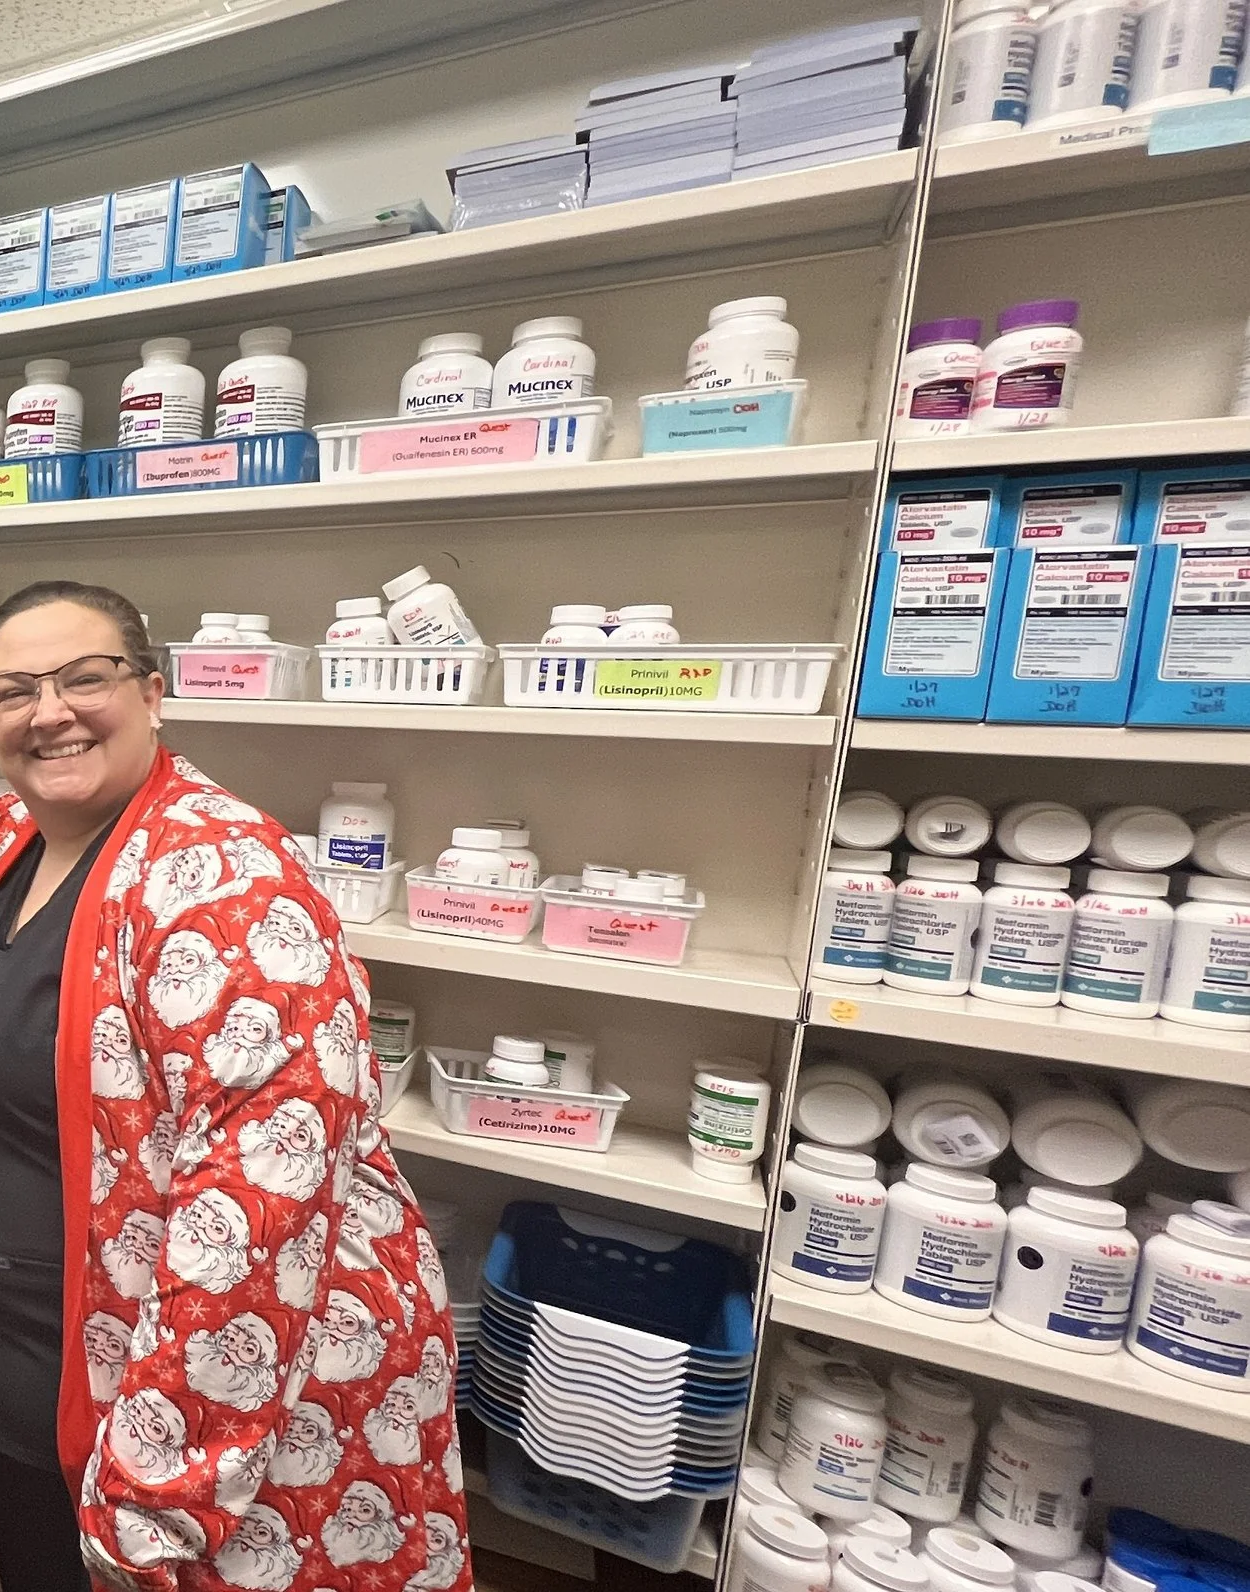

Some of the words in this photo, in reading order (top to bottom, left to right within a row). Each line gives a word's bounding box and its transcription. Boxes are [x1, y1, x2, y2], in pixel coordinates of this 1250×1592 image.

[523, 355, 576, 373] Cardinal
[416, 369, 462, 388] Cardinal
[508, 379, 573, 397] Mucinex
[406, 392, 463, 410] Mucinex
[420, 433, 461, 444] Mucinex
[464, 431, 477, 441] ER
[470, 445, 504, 457] 600mg
[900, 530, 911, 539] 10
[631, 669, 669, 679] Prinivil
[443, 898, 476, 910] Prinivil
[836, 900, 883, 910] Metformin
[995, 917, 1049, 930] Metformin
[926, 928, 950, 937] USP
[1113, 946, 1139, 955] USP
[511, 1107, 542, 1119] Zyrtec
[810, 1207, 861, 1224] Metformin
[922, 1231, 978, 1249] Metformin
[1201, 1312, 1230, 1325] USP
